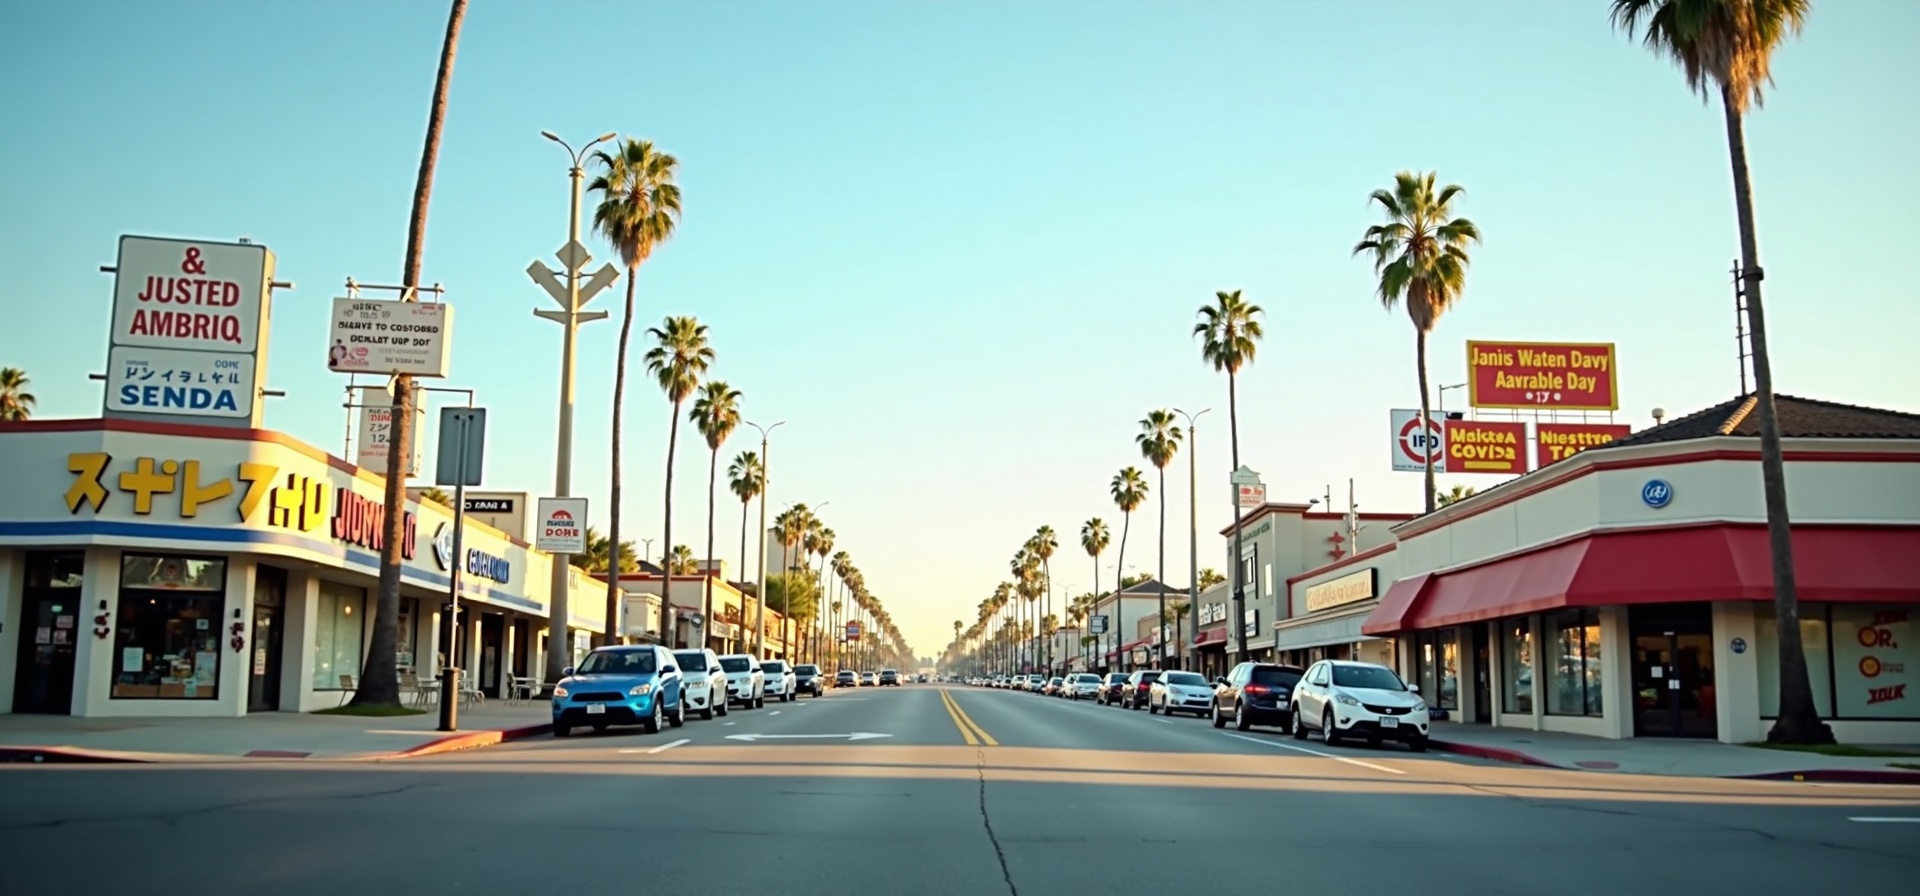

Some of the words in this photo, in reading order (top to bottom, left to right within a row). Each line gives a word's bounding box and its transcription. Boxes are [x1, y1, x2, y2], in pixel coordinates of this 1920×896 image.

[181, 246, 206, 275] &
[138, 275, 240, 307] JUSTED
[129, 309, 242, 344] AMBRIQ
[1517, 349, 1566, 368] Waten
[1570, 350, 1608, 372] Davy
[1495, 370, 1563, 389] Aavrable
[1567, 371, 1596, 393] Day
[120, 384, 237, 411] SENDA
